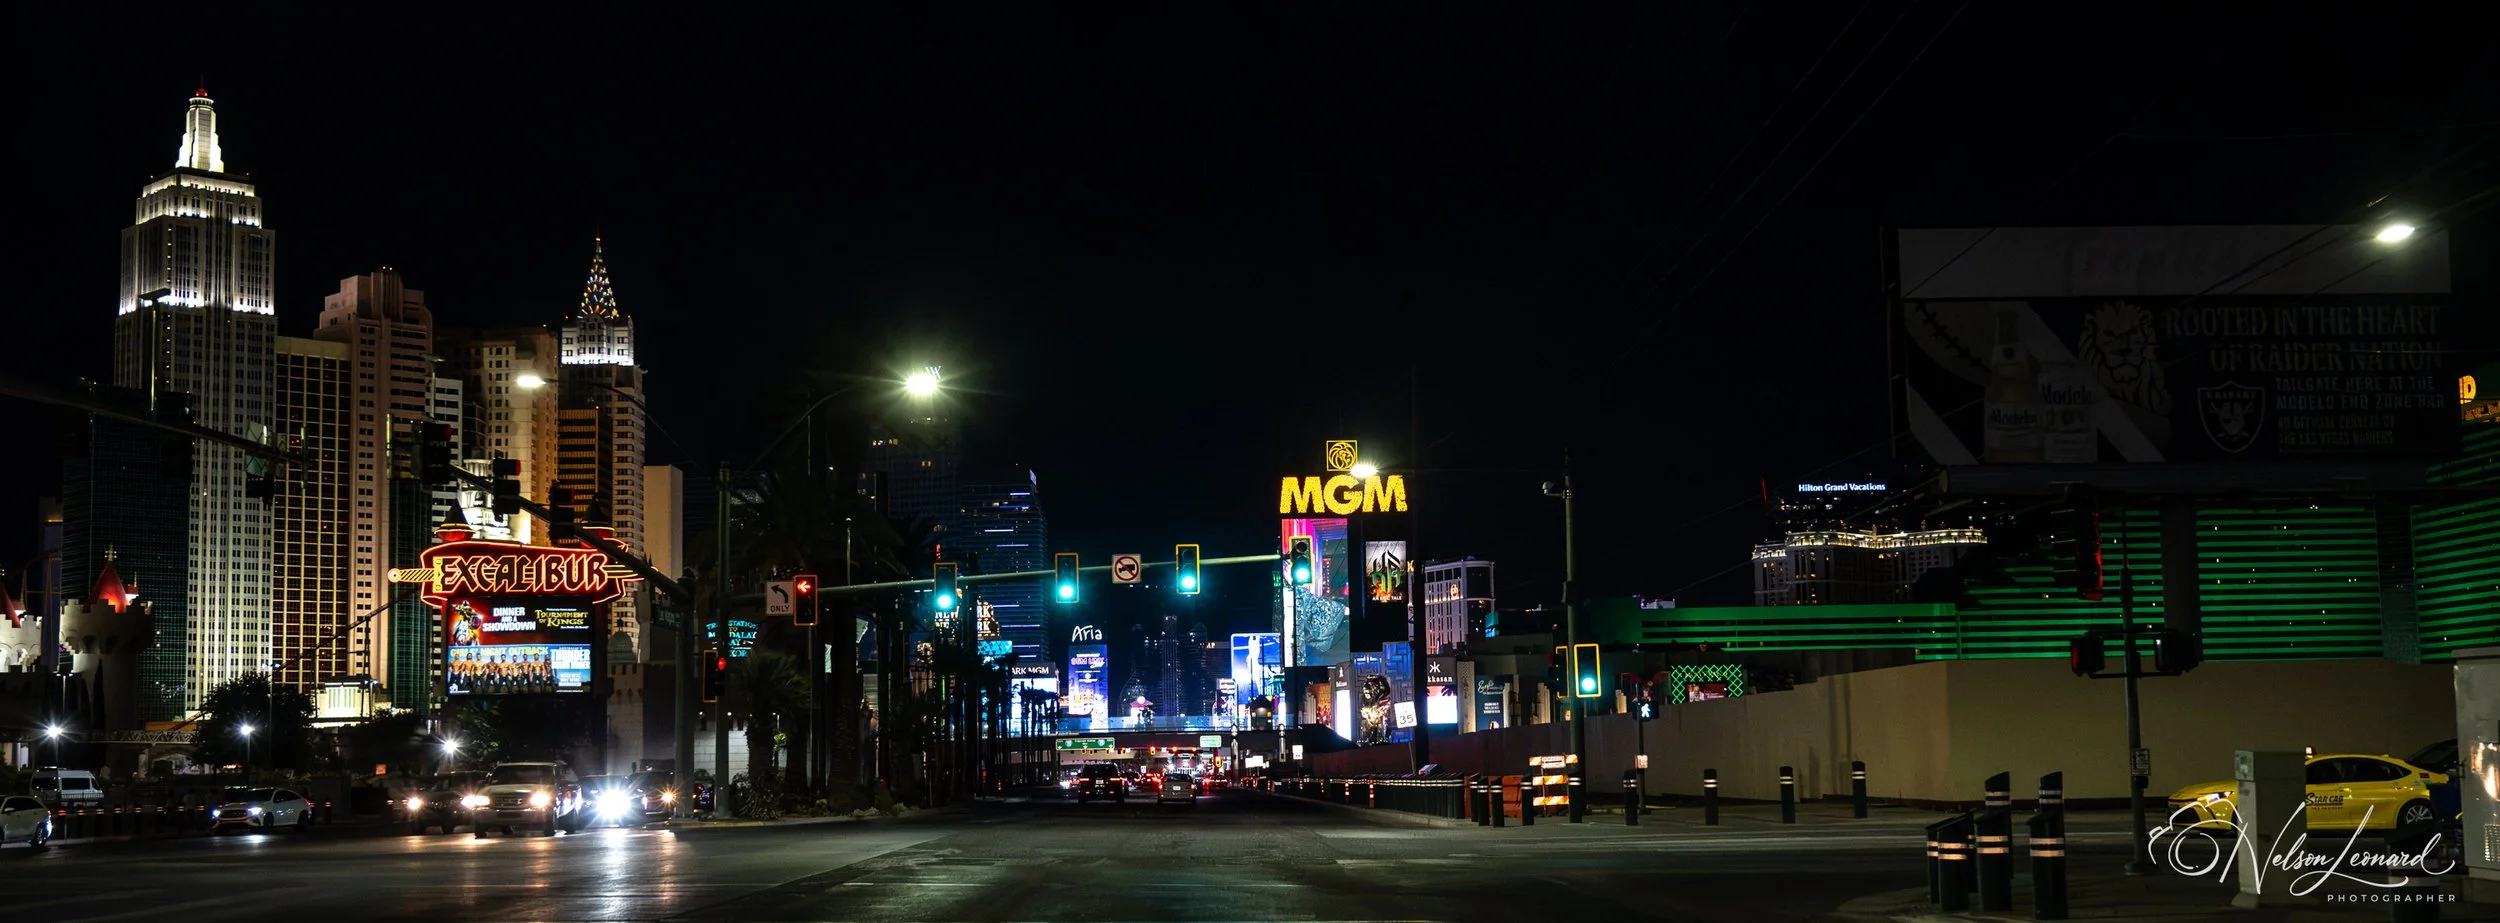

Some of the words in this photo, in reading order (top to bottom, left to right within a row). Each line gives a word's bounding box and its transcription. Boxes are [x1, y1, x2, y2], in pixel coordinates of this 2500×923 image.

[2166, 307, 2268, 337] ROOTED
[2274, 306, 2298, 337] IN
[2301, 305, 2351, 336] THE
[2357, 304, 2441, 336] HEART
[2249, 342, 2344, 372] RAIDER
[2350, 341, 2443, 371] NATION
[2275, 376, 2340, 392] TAILGATE
[2345, 376, 2383, 392] HERE
[2388, 376, 2404, 391] AT
[2408, 375, 2436, 391] THE
[2276, 394, 2336, 411] MODELO
[2341, 394, 2369, 410] END
[2375, 394, 2412, 410] ZONE
[2418, 393, 2446, 409] BAR
[1798, 483, 1823, 492] Hilton
[1824, 483, 1848, 492] Grand
[1849, 482, 1886, 491] Vacations
[1280, 474, 1409, 515] MGM
[440, 553, 608, 593] EXCALIBUR
[493, 607, 526, 617] DINNER
[535, 609, 589, 619] TOURNAMENT
[770, 605, 790, 613] ONLY
[482, 621, 537, 632] SHOWDOWN
[546, 618, 584, 627] KINGS
[1071, 625, 1103, 642] Aria
[509, 646, 549, 655] OUTBACK
[1028, 666, 1049, 674] MGM
[1399, 715, 1414, 725] 35
[2305, 792, 2328, 806] STAR
[2329, 795, 2344, 804] CAB
